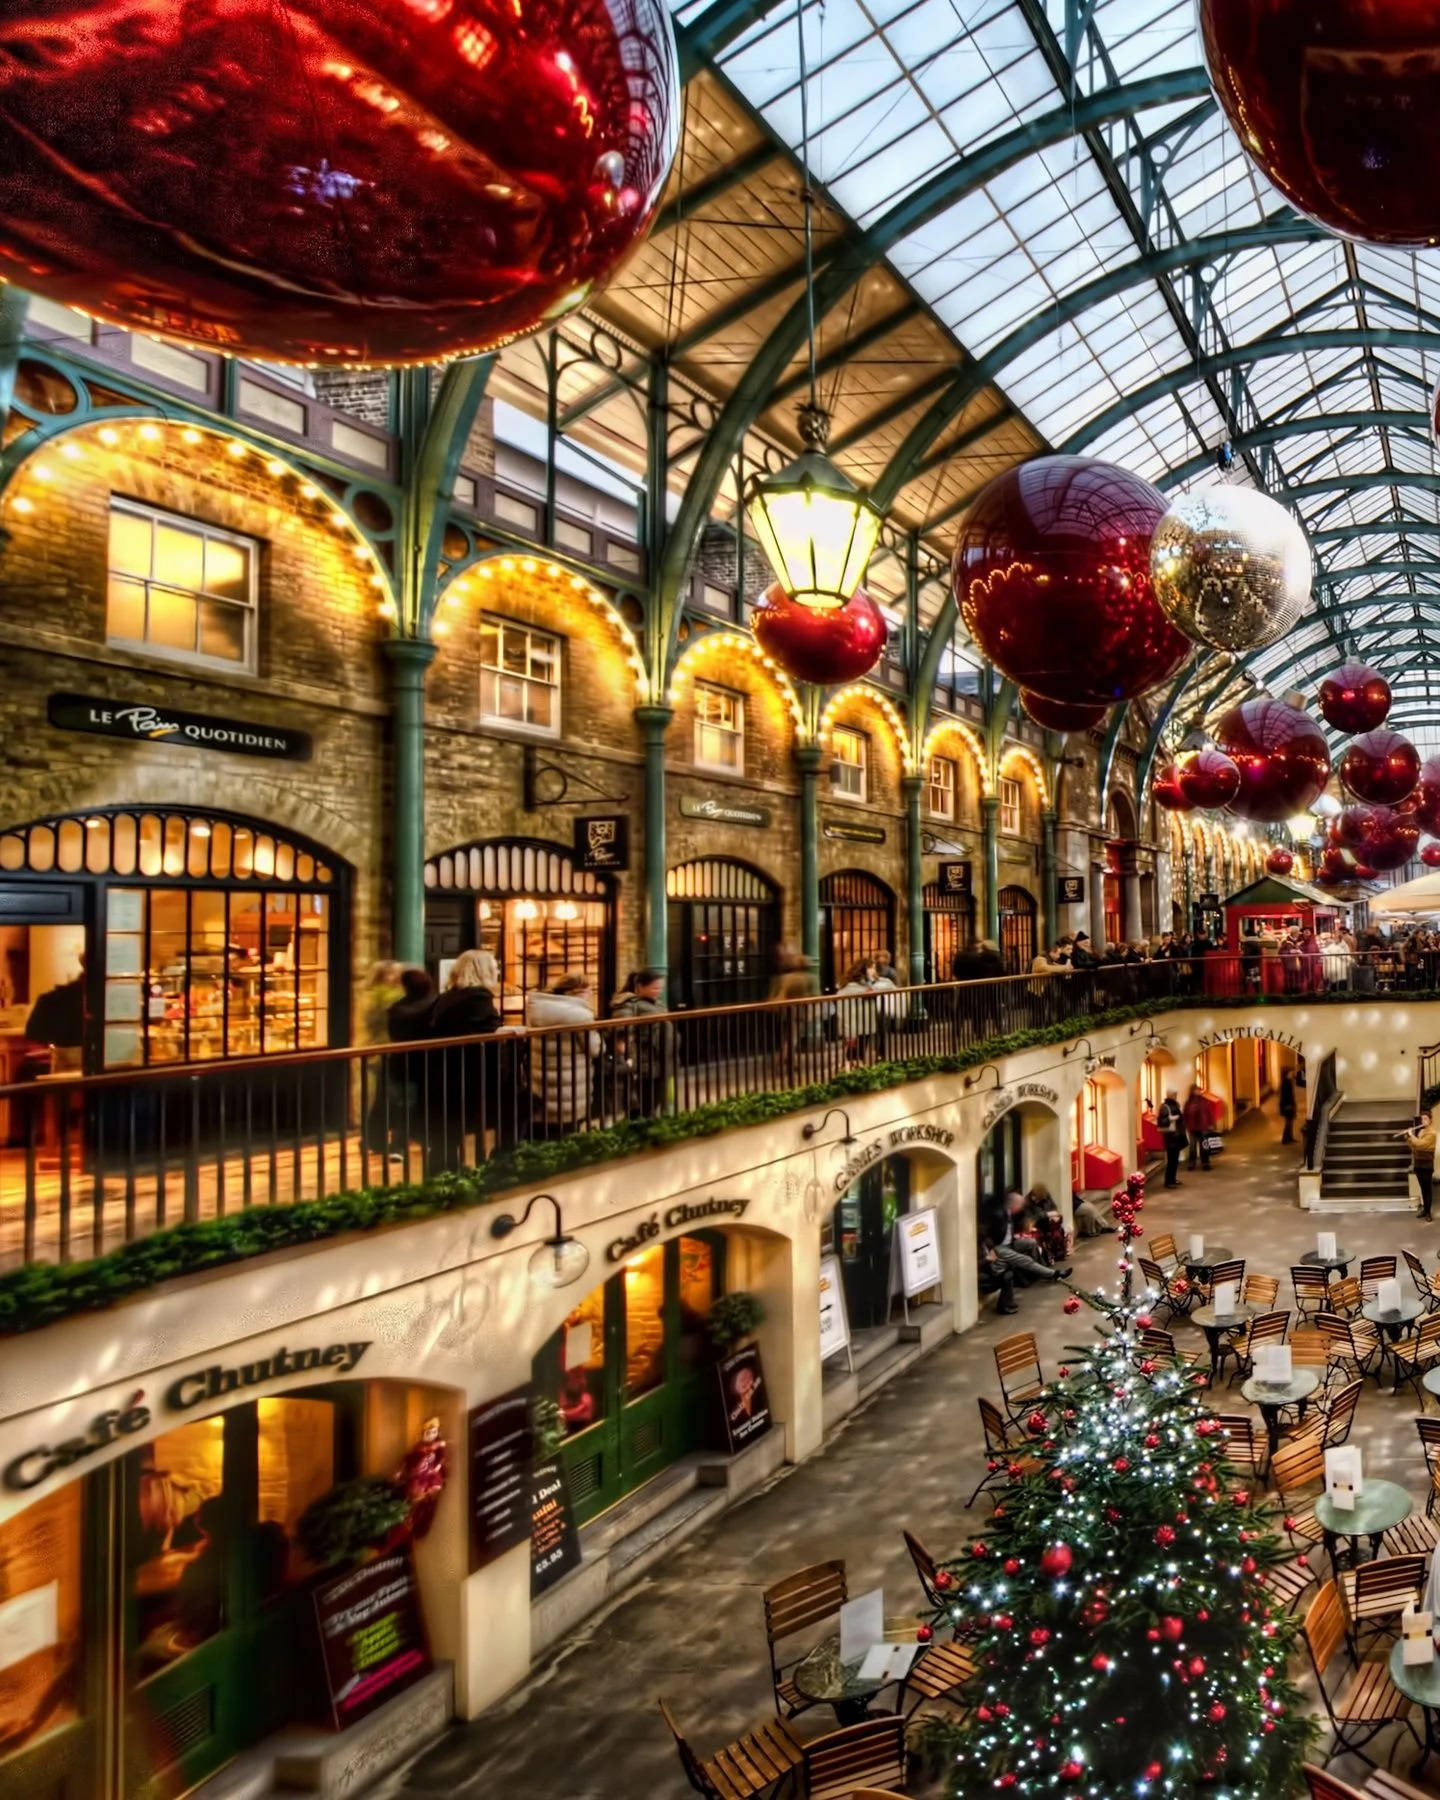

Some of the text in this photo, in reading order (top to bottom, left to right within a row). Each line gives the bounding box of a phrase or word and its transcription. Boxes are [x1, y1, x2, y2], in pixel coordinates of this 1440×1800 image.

[89, 707, 288, 750] LE Pain QUOTIDIEN
[1197, 1026, 1304, 1053] NAUTICALIA
[888, 1124, 955, 1148] WORKSHOP
[604, 1196, 751, 1263] Café Chutney
[1, 1340, 373, 1493] Café Chutney
